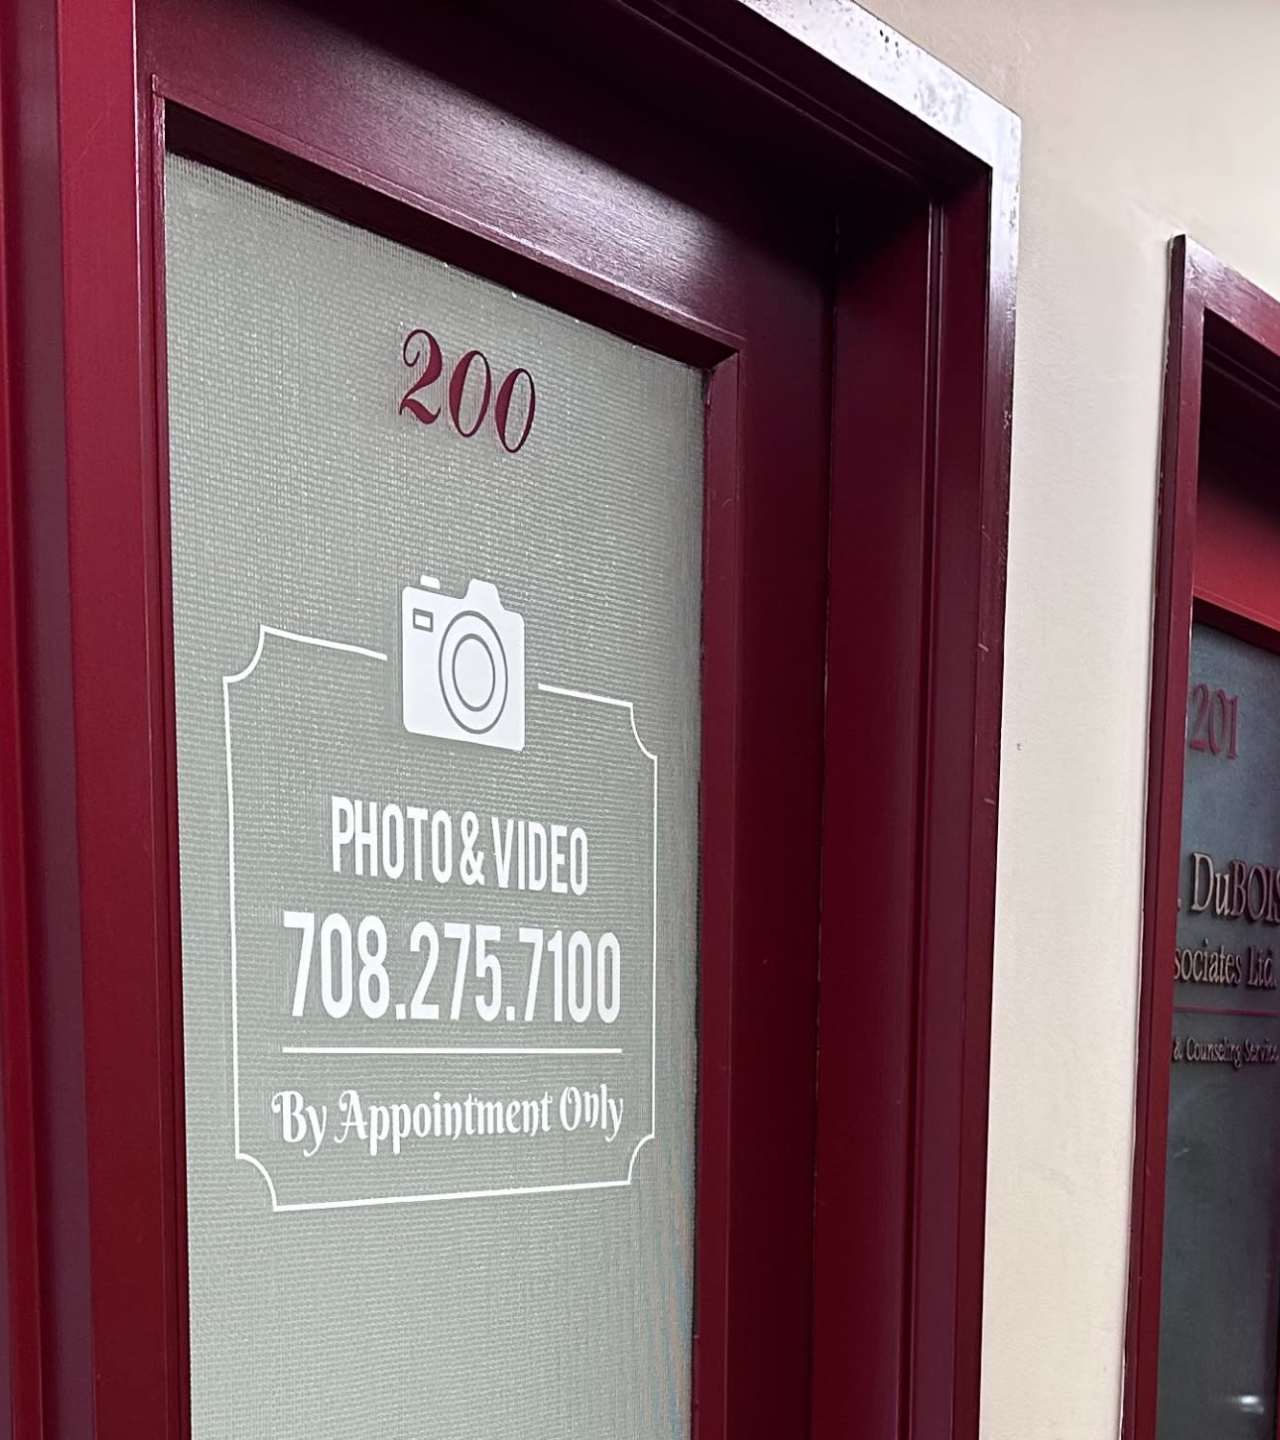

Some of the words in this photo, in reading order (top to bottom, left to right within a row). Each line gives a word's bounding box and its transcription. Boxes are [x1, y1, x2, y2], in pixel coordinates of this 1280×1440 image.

[399, 329, 536, 453] 200
[1189, 684, 1238, 759] 201
[331, 796, 453, 884] PHOTO
[491, 816, 589, 895] VIDEO
[283, 910, 621, 1023] 708.275.7100
[271, 1089, 328, 1157] By
[334, 1089, 553, 1156] Appointment
[559, 1084, 624, 1142] Only
